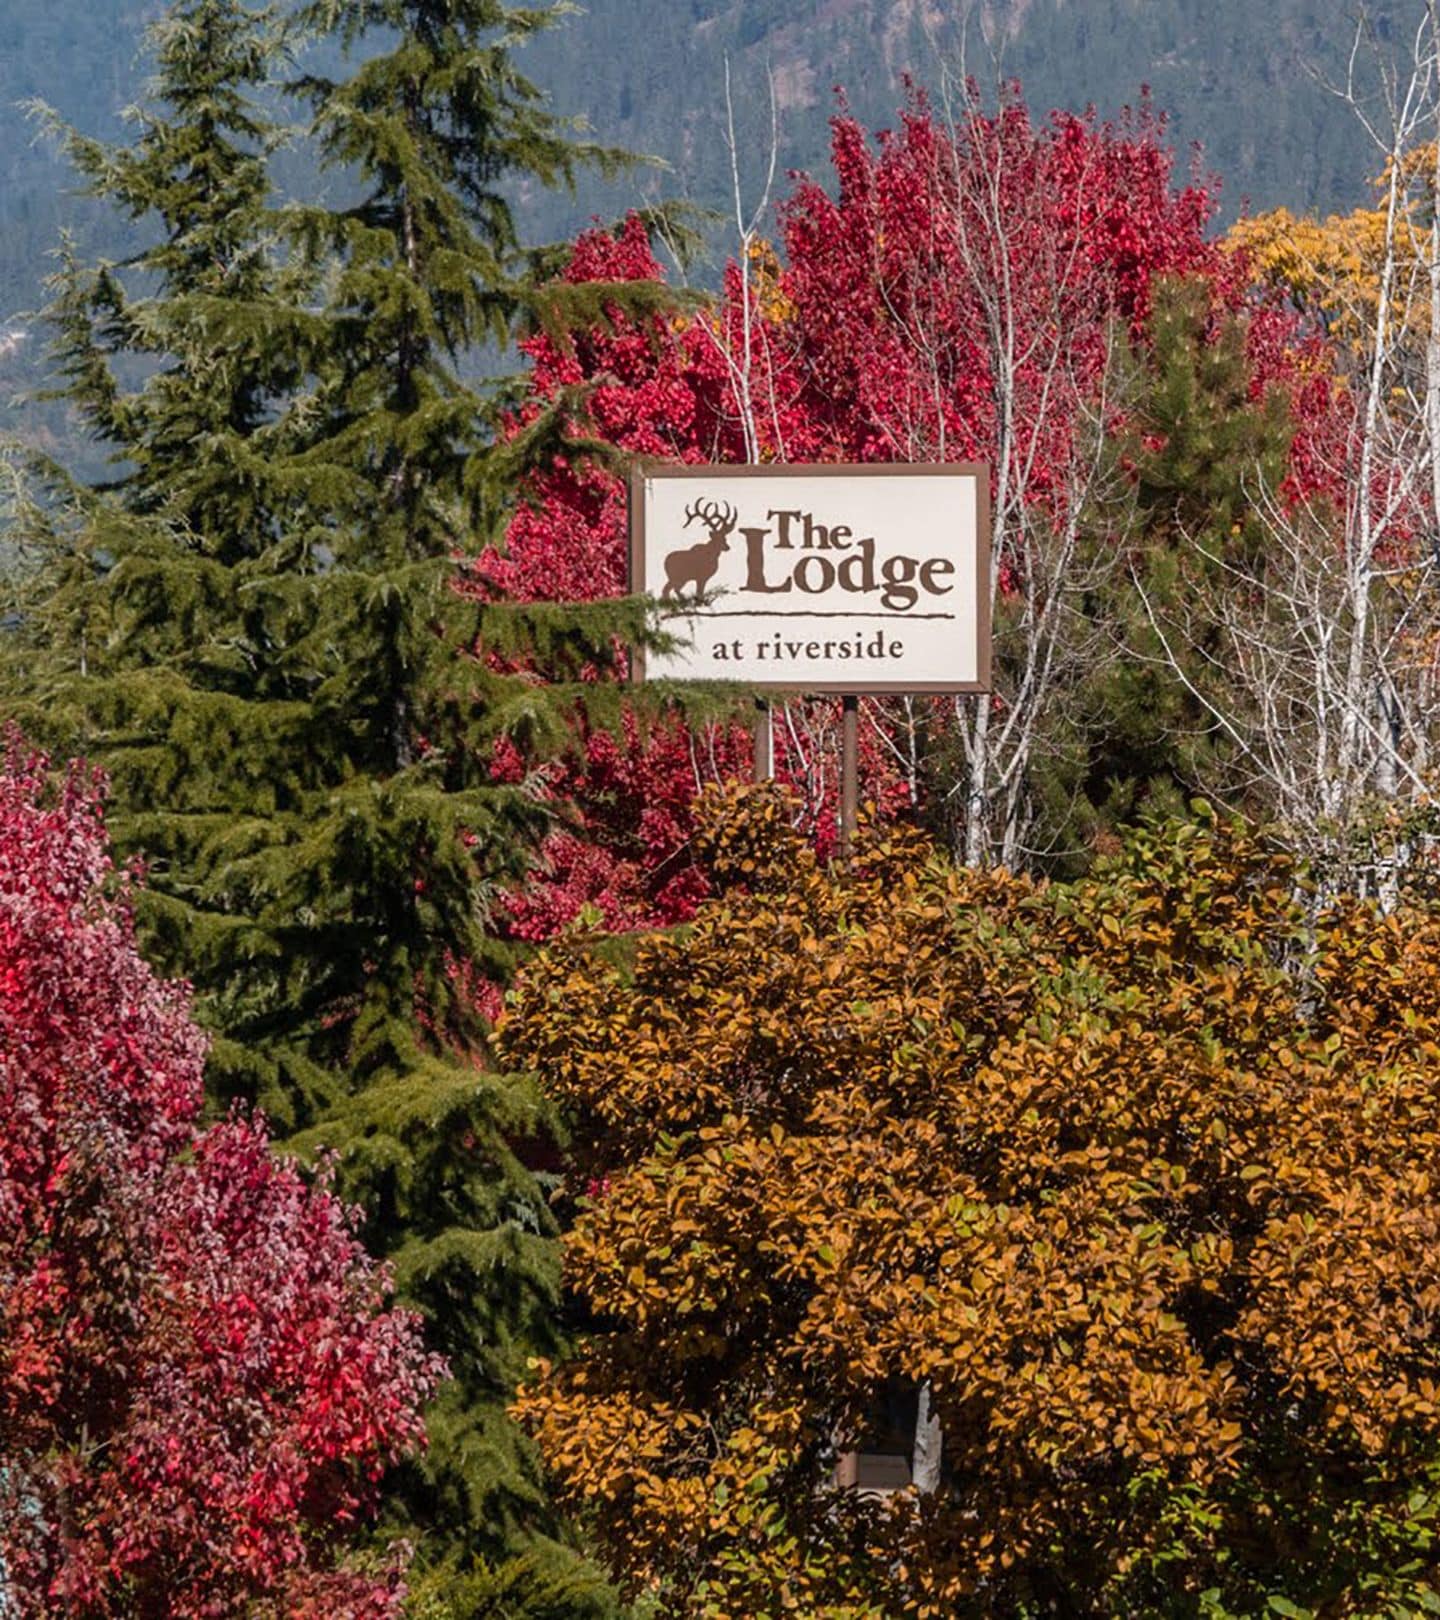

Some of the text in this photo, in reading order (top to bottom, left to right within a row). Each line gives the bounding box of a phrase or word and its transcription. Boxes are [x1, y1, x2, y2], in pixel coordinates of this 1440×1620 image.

[766, 509, 853, 550] The
[738, 527, 956, 612] Lodge
[712, 630, 905, 661] at riverside
